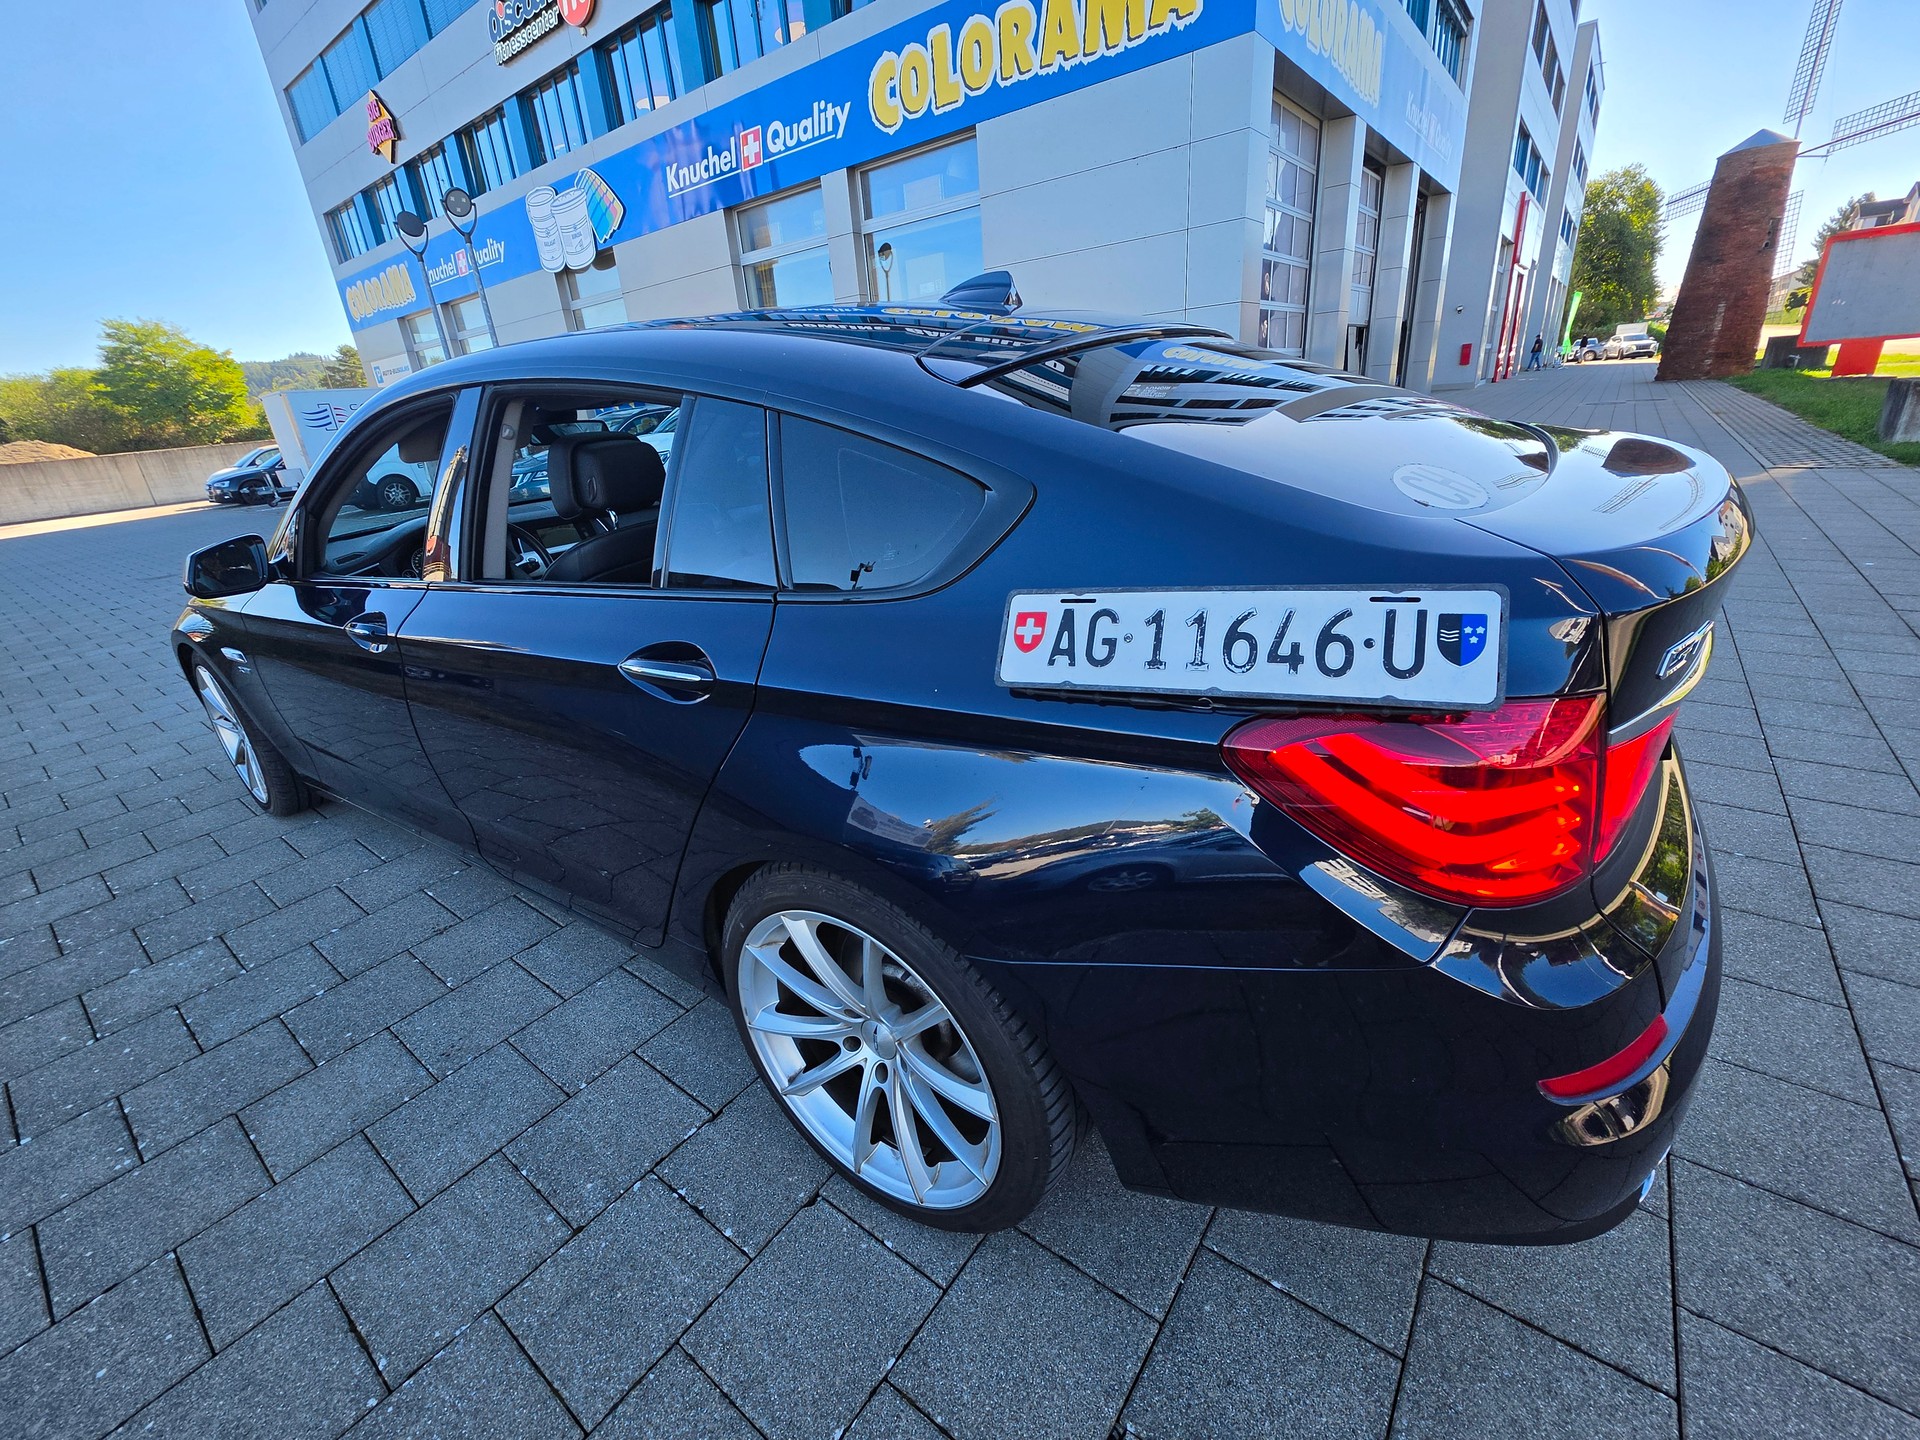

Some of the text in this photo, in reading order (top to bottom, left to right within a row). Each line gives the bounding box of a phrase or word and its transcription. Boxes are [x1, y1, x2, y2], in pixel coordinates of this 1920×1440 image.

[494, 5, 560, 65] fitnesscenter
[666, 99, 851, 192] Knuchel Quality
[346, 264, 416, 322] COLORAMA
[426, 254, 456, 283] nuchel
